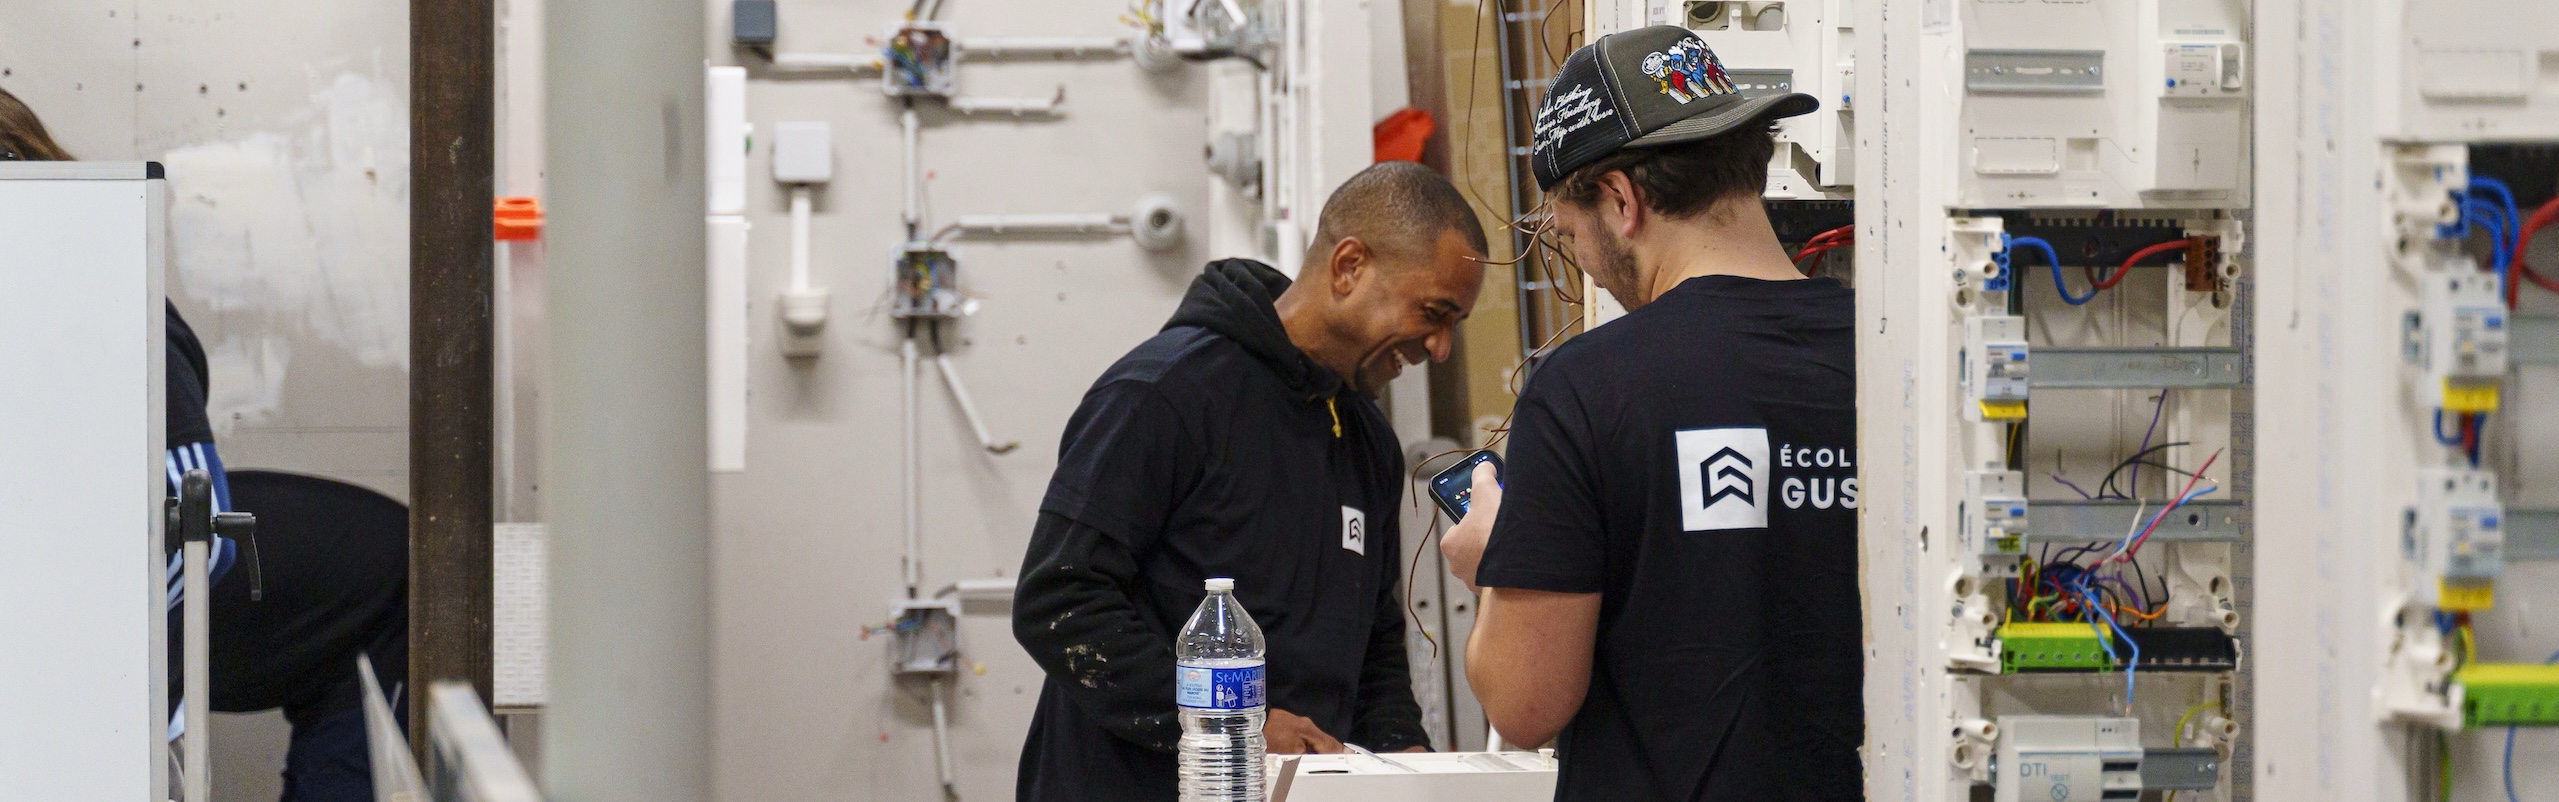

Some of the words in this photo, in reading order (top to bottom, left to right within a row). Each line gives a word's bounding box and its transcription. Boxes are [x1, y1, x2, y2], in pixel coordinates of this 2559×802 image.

[1779, 444, 1858, 468] ÉCOL
[1781, 477, 1858, 510] GUS
[2020, 762, 2047, 778] DTI
